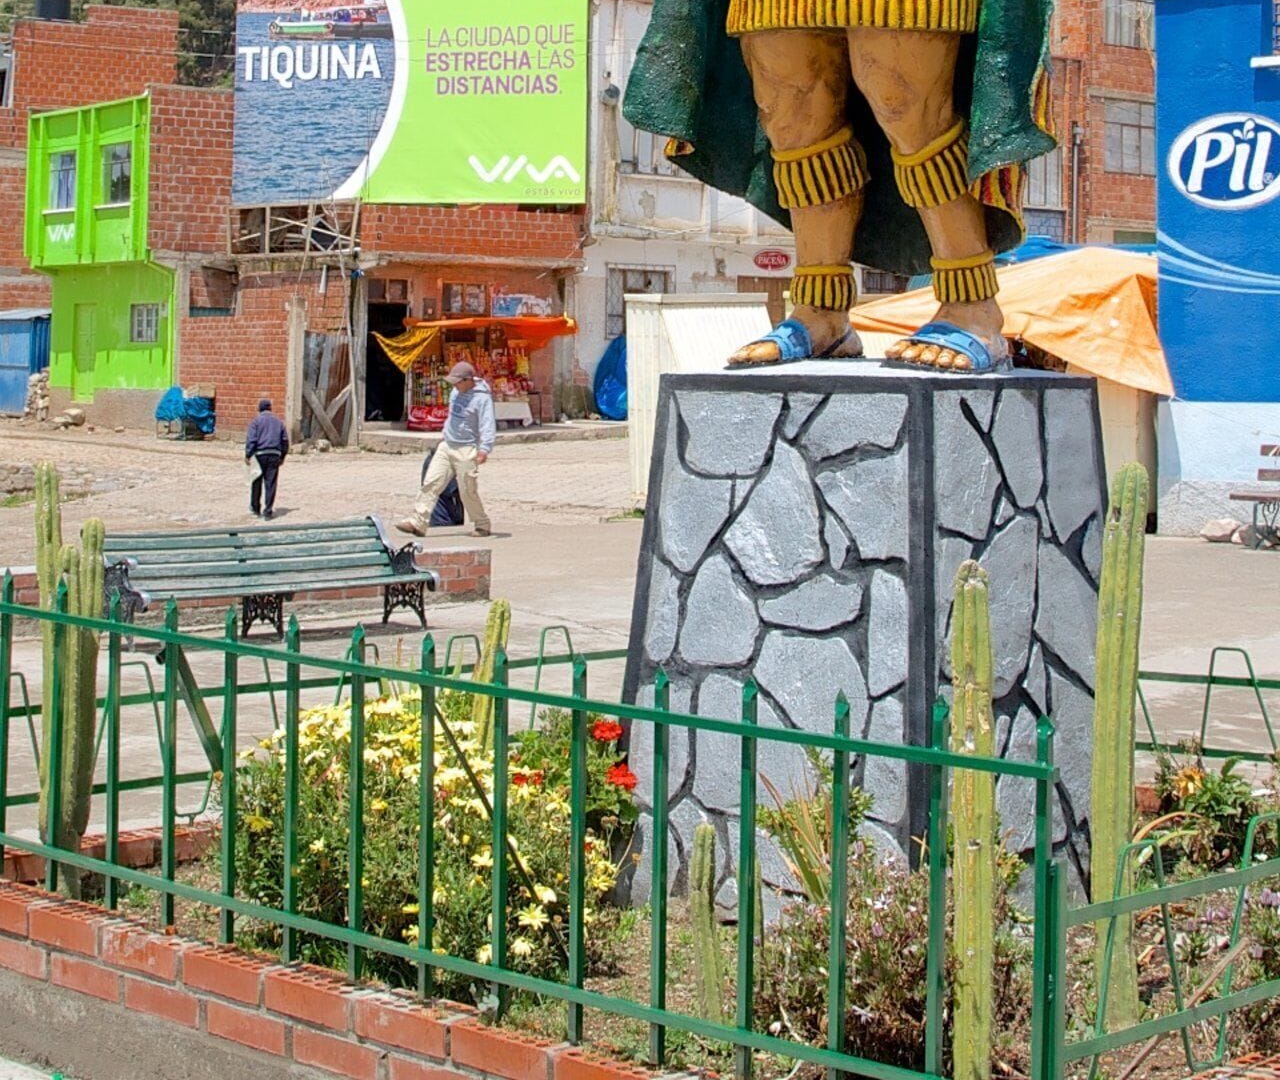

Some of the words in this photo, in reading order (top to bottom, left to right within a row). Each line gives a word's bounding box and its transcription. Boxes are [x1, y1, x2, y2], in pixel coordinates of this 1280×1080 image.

[426, 28, 452, 48] LA
[455, 25, 531, 47] CIUDAD
[535, 23, 575, 49] QUE
[238, 43, 382, 88] TIQUINA
[426, 50, 531, 72] ESTRECHA
[537, 48, 576, 69] LAS
[436, 74, 563, 95] DISTANCIAS.
[468, 154, 581, 184] VIVA
